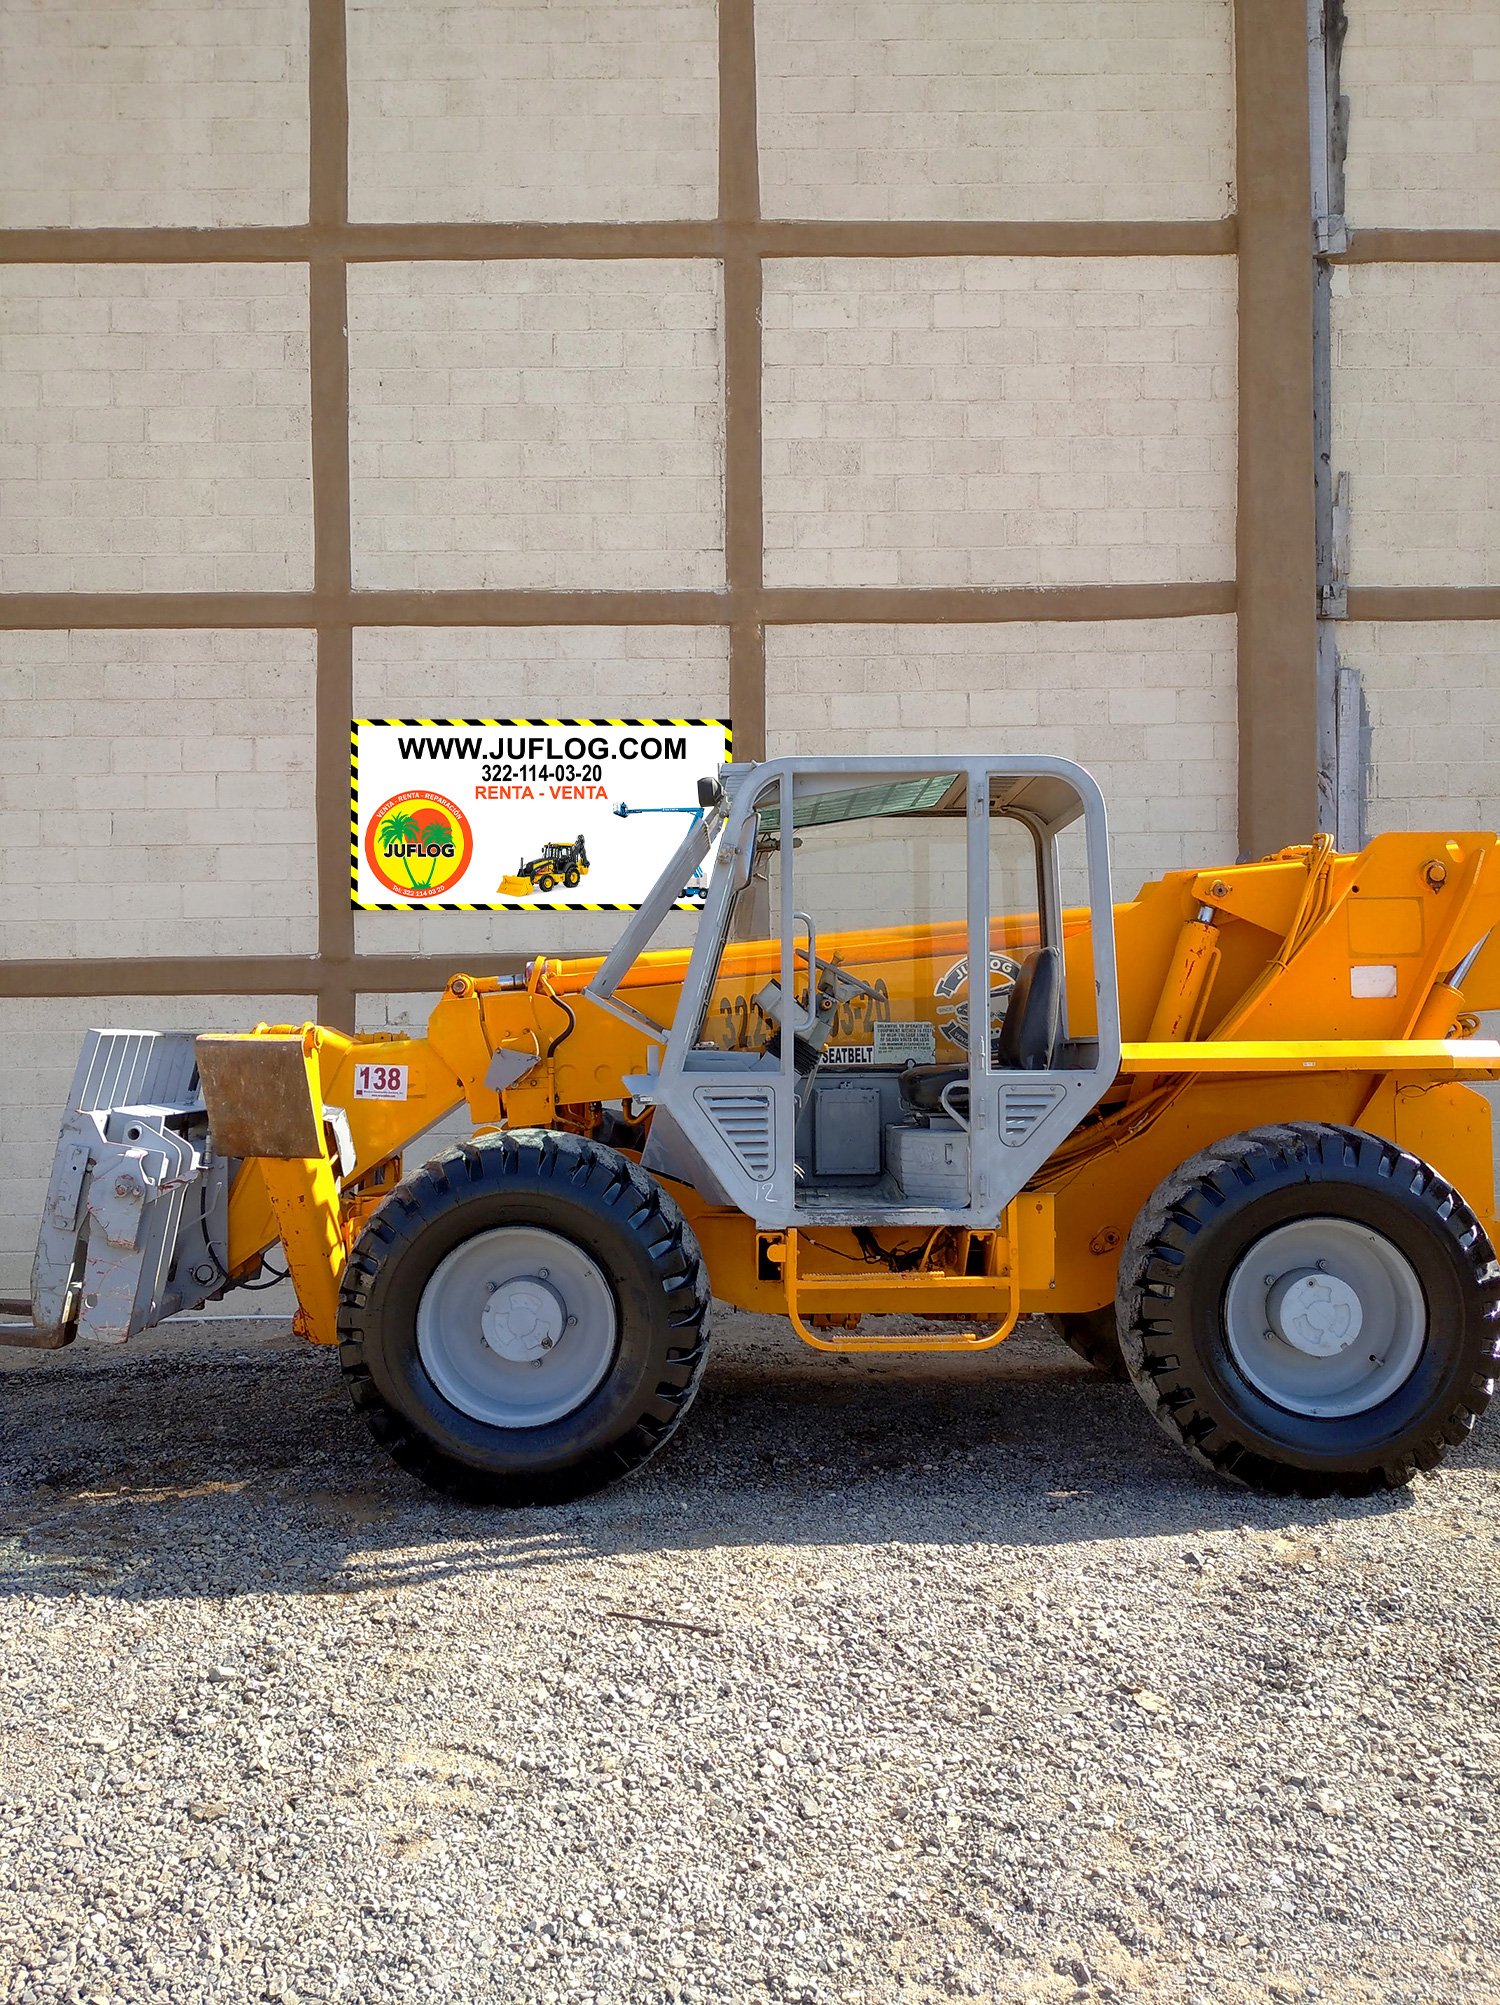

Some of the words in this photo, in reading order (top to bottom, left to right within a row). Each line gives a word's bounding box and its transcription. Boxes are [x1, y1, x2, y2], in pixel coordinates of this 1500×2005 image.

[398, 737, 687, 760] WWW.JUFLOG.COM
[481, 764, 602, 782] 322-114-03-20
[475, 785, 534, 800] RENTA
[549, 785, 609, 800] VENTA
[376, 801, 395, 819] VENTA
[397, 792, 420, 802] RENTA
[383, 843, 455, 858] JUFLOG
[402, 888, 414, 897] 322
[415, 889, 428, 897] 114
[428, 888, 437, 896] 03
[437, 885, 445, 893] 20
[822, 1047, 873, 1063] SEATBELT
[360, 1066, 401, 1090] 138
